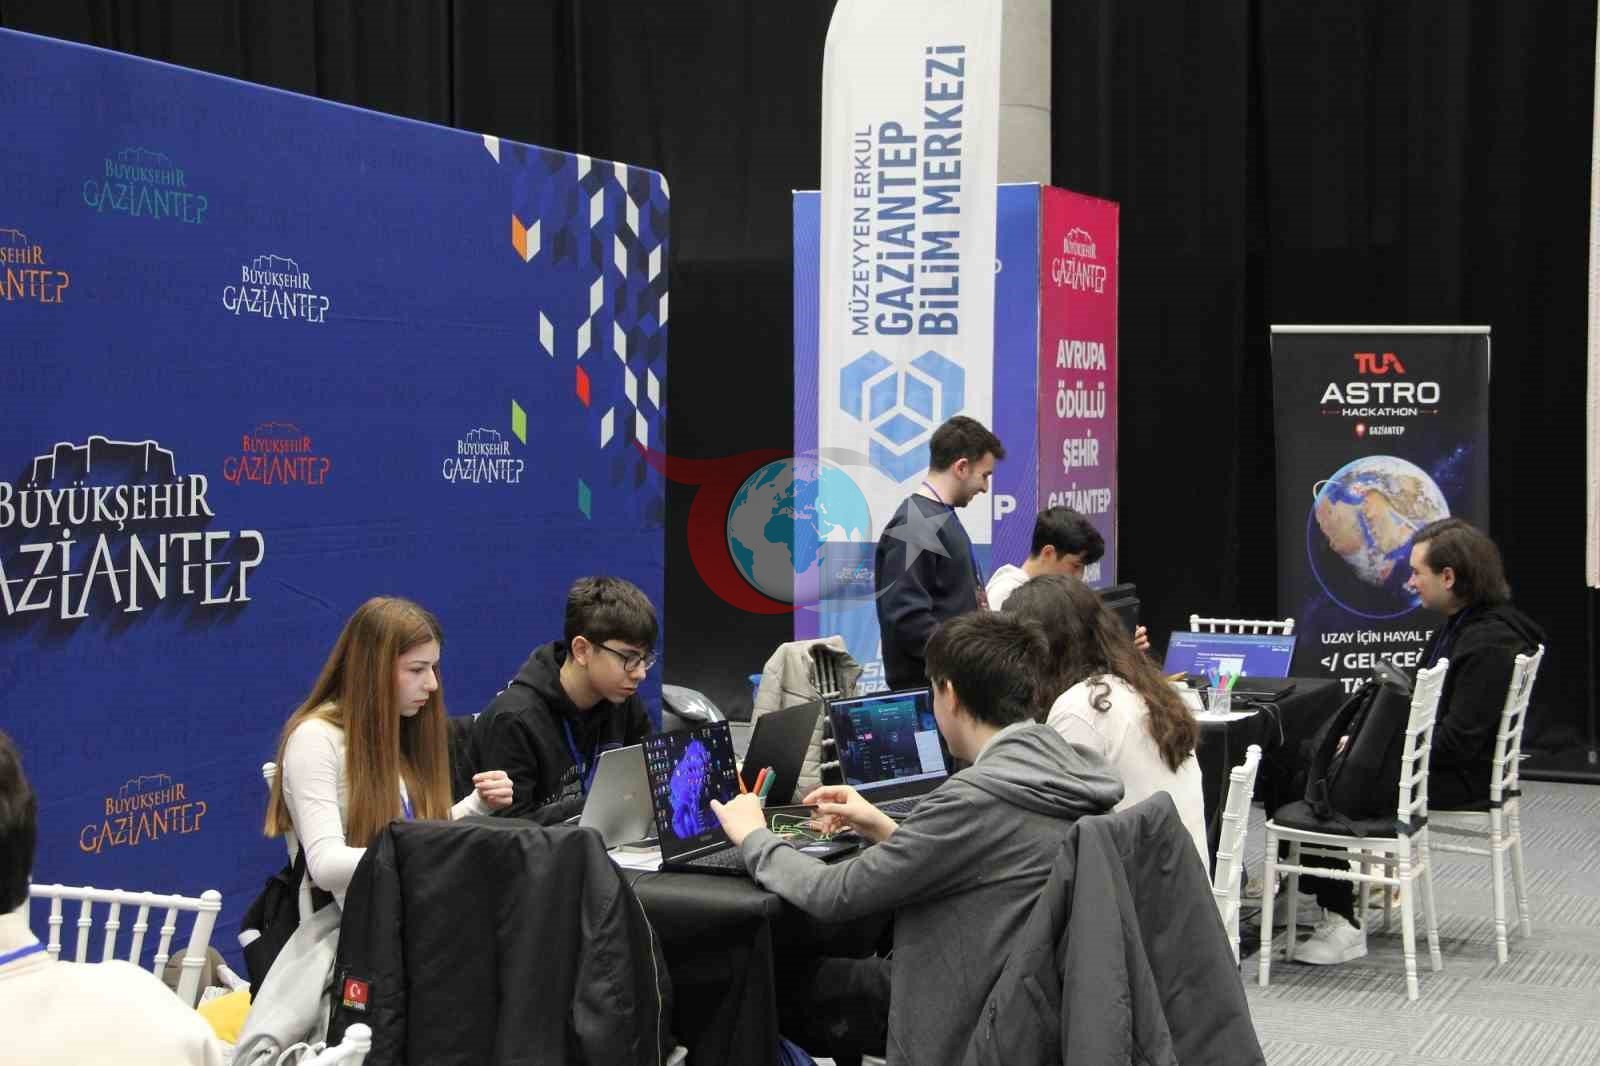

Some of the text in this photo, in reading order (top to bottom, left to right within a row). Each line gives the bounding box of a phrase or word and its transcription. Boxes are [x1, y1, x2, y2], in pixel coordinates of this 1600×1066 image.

[918, 44, 966, 337] BİLİM MERKEZİ
[848, 124, 872, 336] MÜZEYYEN ERKUL
[875, 120, 917, 337] GAZİANTEP
[0, 267, 70, 304] NTEP
[222, 285, 330, 324] GAZİANTEP
[1056, 338, 1107, 371] AVRUPA
[1056, 380, 1106, 419] ÖDÜLLÜ
[1320, 382, 1441, 405] ASTRO
[1341, 407, 1418, 417] HACKATHON
[442, 455, 525, 484] GAZİANTEP
[1063, 428, 1099, 475] ŞEHİR
[0, 473, 215, 531] BÜYÜKŞEHİR
[1048, 482, 1111, 514] GAZİANTEP
[0, 528, 265, 619] AZİANTEP
[1321, 631, 1354, 644] UZAY
[1357, 629, 1381, 646] İÇİN
[1383, 630, 1423, 643] HAYAL
[79, 800, 207, 854] GAZİANTEP
